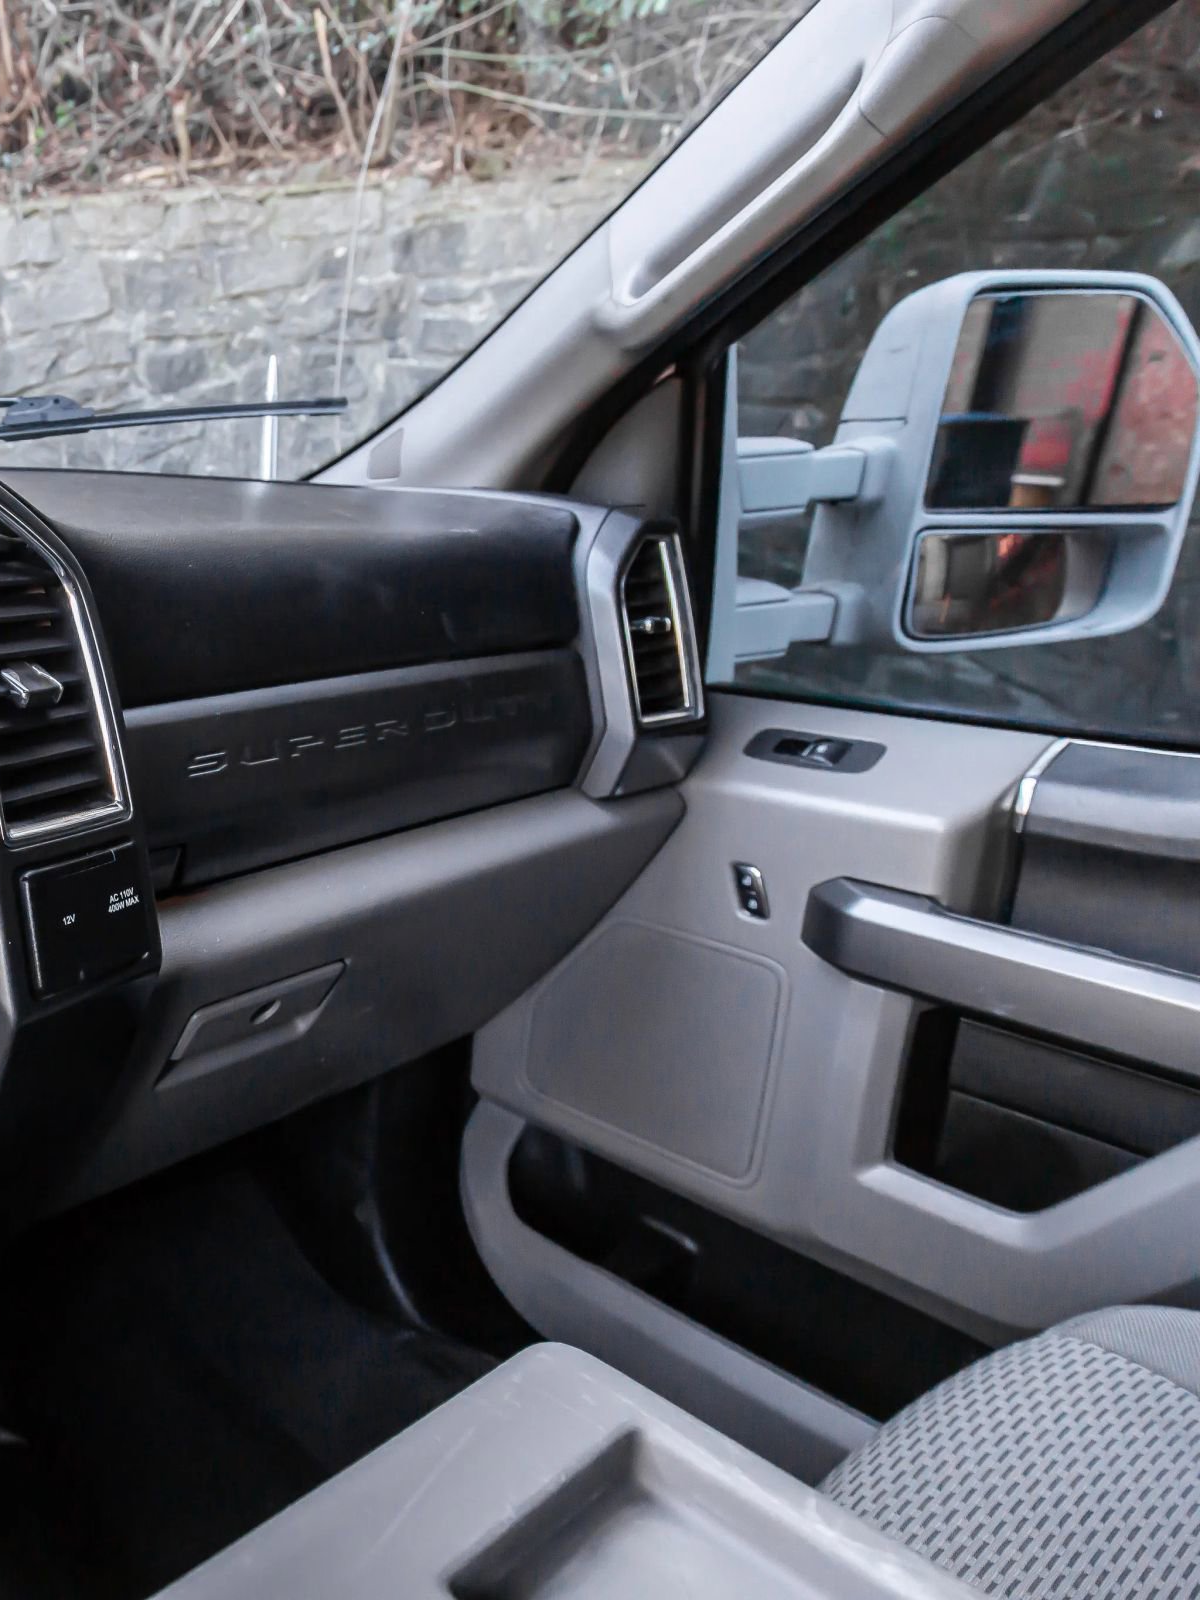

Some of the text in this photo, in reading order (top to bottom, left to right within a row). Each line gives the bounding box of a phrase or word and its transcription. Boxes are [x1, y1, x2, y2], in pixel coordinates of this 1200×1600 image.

[109, 886, 134, 904] AC 110V
[108, 895, 140, 914] 400W MAX
[62, 913, 76, 926] 12V
